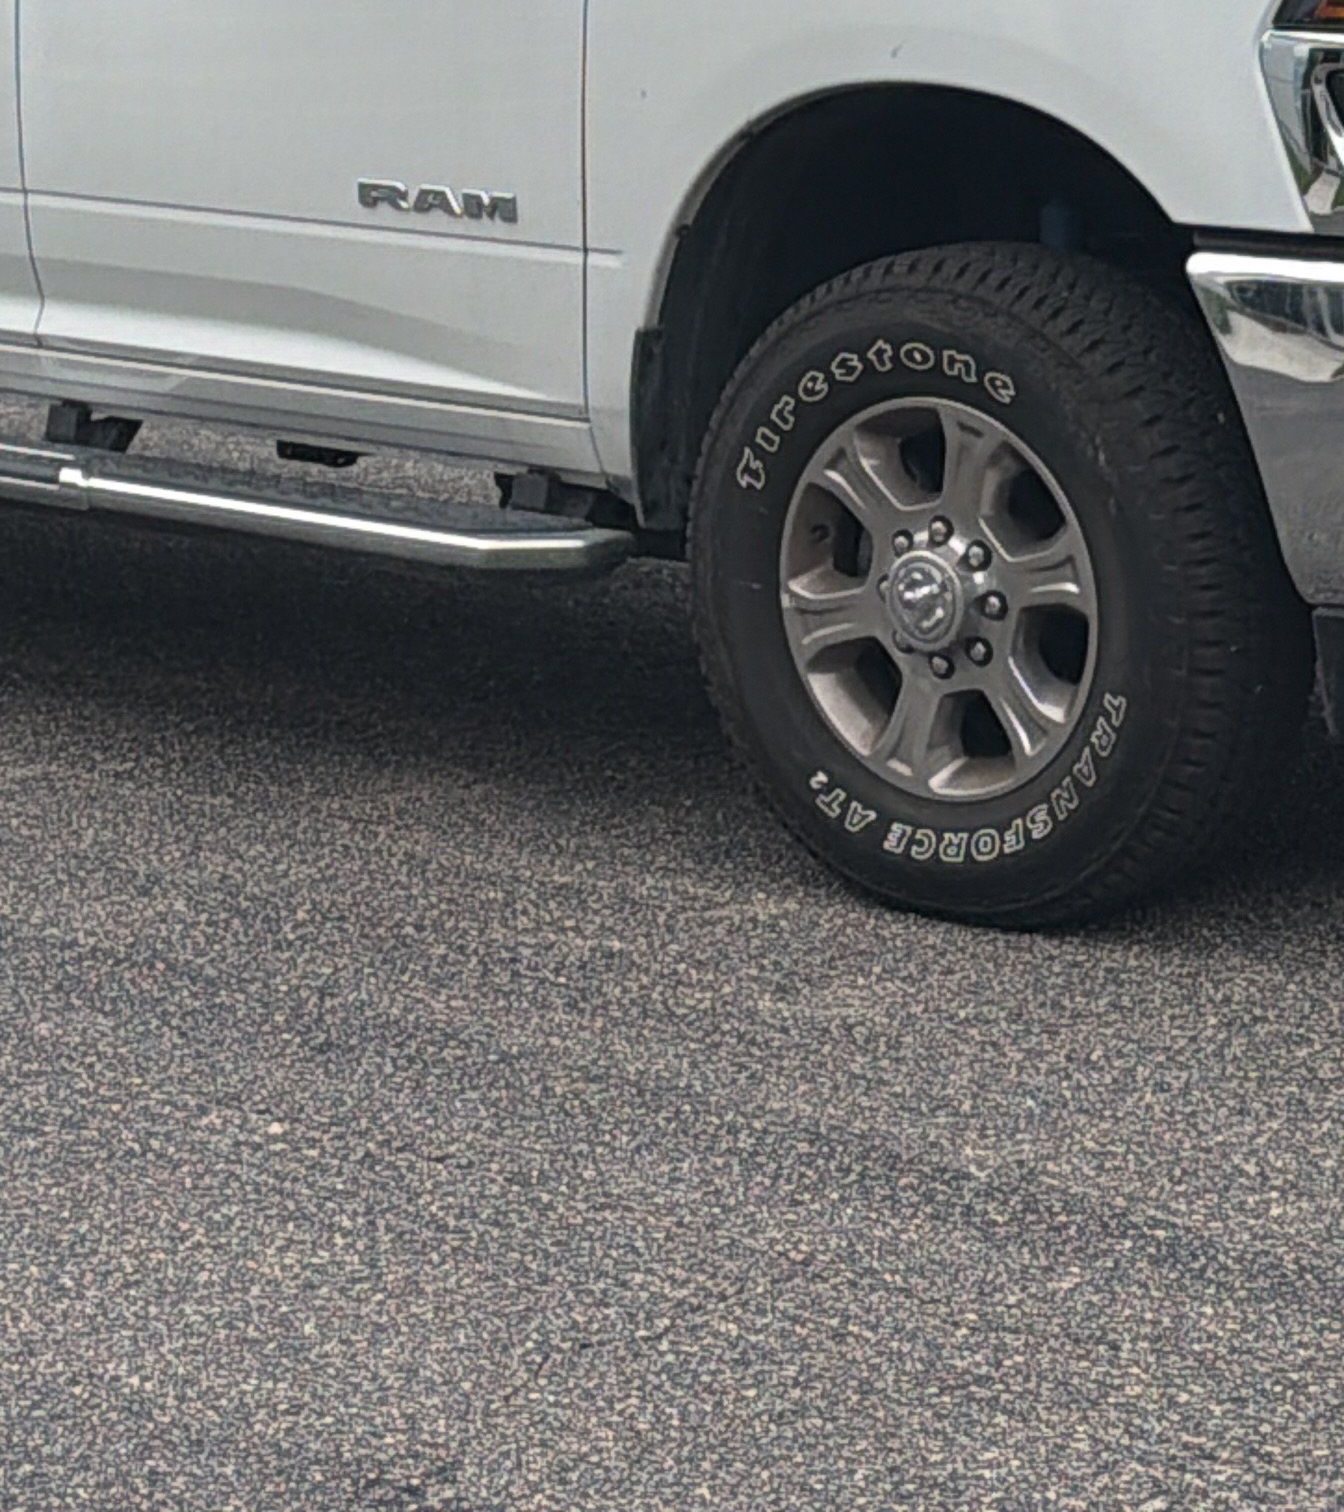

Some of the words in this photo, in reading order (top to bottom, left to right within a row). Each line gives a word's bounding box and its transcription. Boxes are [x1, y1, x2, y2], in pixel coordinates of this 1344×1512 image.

[356, 177, 518, 224] RAM
[735, 339, 1017, 491] Firestone
[882, 691, 1128, 863] TRANSFORCE
